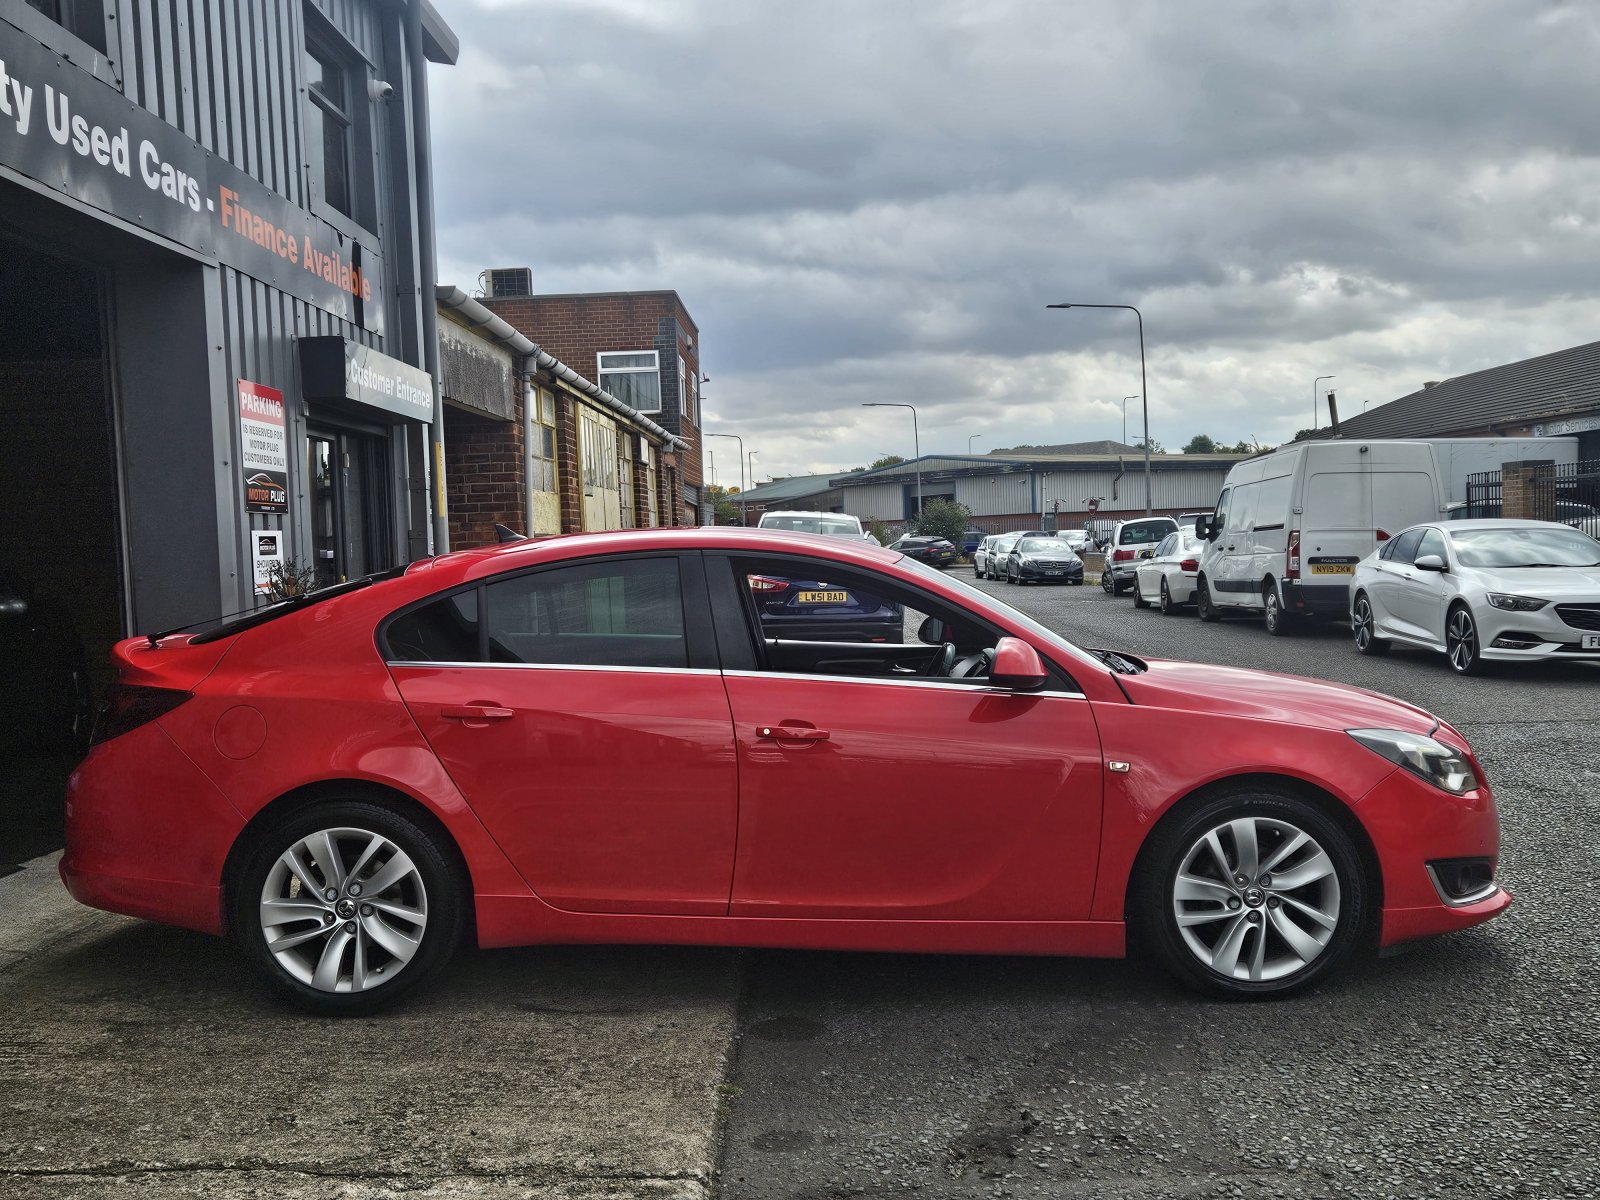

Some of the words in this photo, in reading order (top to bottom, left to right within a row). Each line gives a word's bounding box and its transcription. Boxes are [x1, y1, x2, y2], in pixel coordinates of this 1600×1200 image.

[0, 59, 32, 135] ty
[45, 84, 131, 177] Used
[139, 139, 201, 212] Cars
[219, 184, 298, 264] Finance
[303, 235, 372, 302] Available
[350, 358, 394, 395] Customer
[396, 376, 431, 408] Entrance
[241, 391, 282, 418] PARKING
[243, 423, 249, 434] IS
[249, 425, 273, 439] RESERVED
[274, 430, 283, 440] FOR
[249, 439, 266, 451] MOTOR
[267, 442, 279, 453] PLUG
[244, 452, 272, 465] CUSTOMERS
[273, 457, 285, 467] ONLY
[248, 488, 269, 501] MOTOR
[270, 490, 285, 502] PLUG
[1316, 565, 1334, 573] NY19
[805, 592, 824, 602] LW51
[827, 592, 844, 601] BAD
[1590, 636, 1600, 647] F
